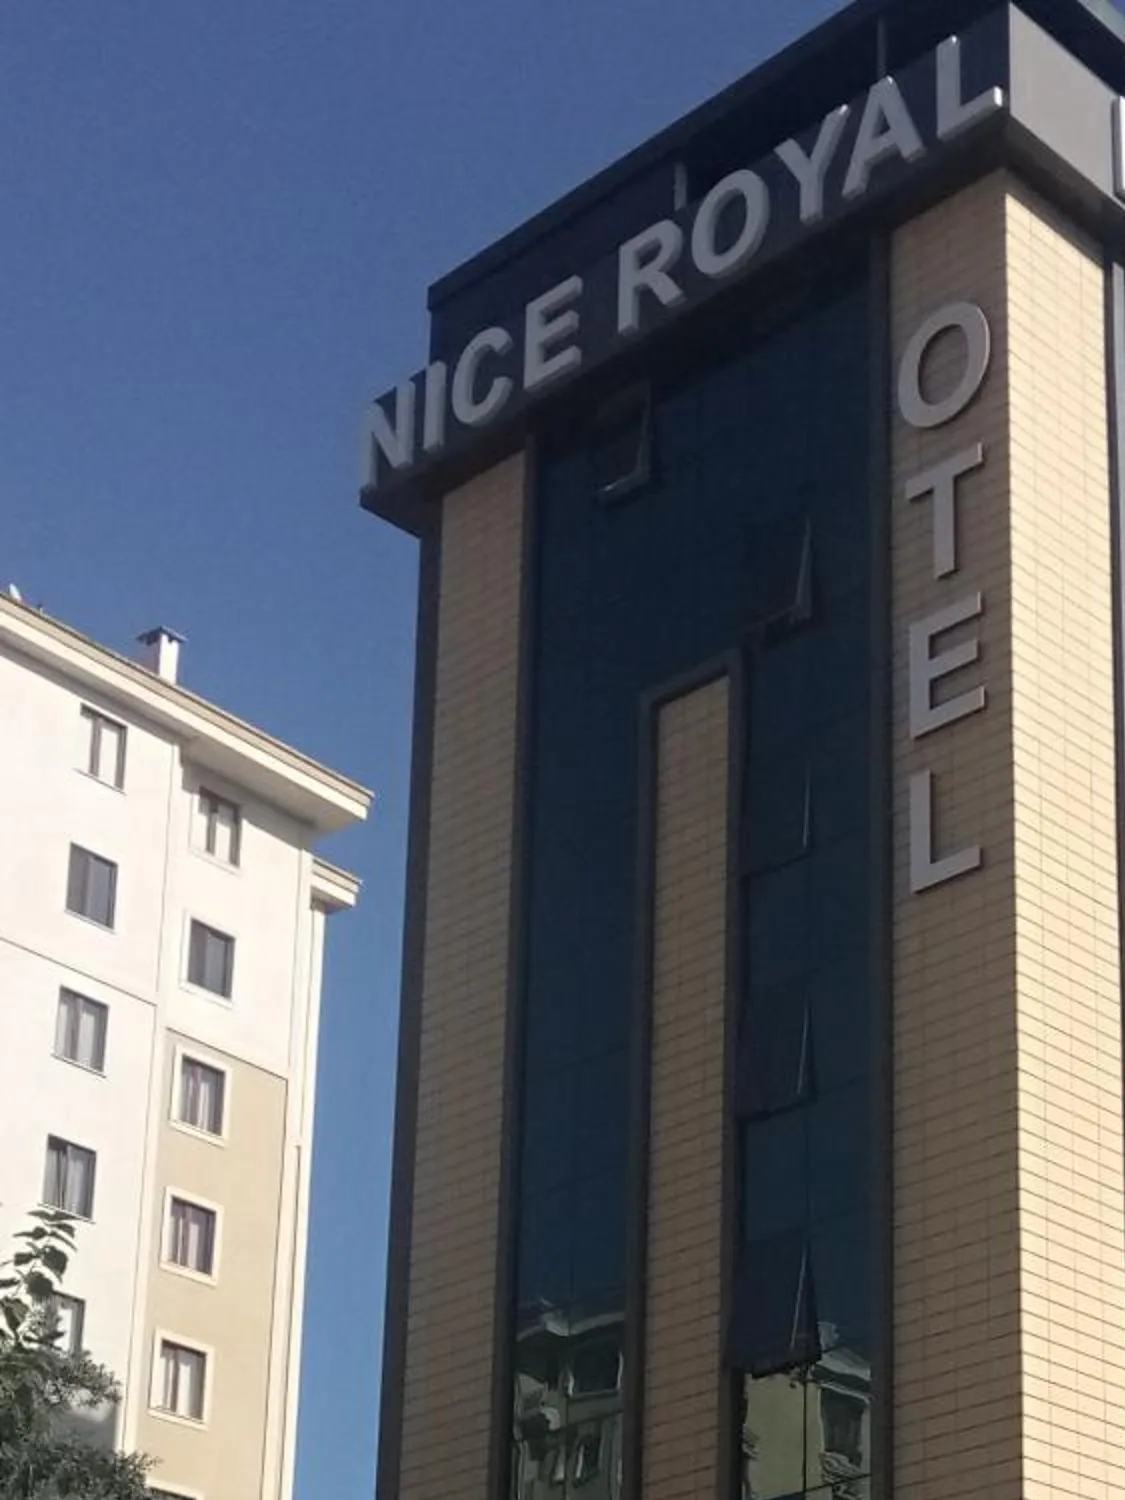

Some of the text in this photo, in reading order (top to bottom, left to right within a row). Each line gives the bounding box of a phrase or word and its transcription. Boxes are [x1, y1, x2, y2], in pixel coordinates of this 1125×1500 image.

[359, 34, 1004, 494] NICE ROYAL
[895, 300, 992, 894] OTEL
